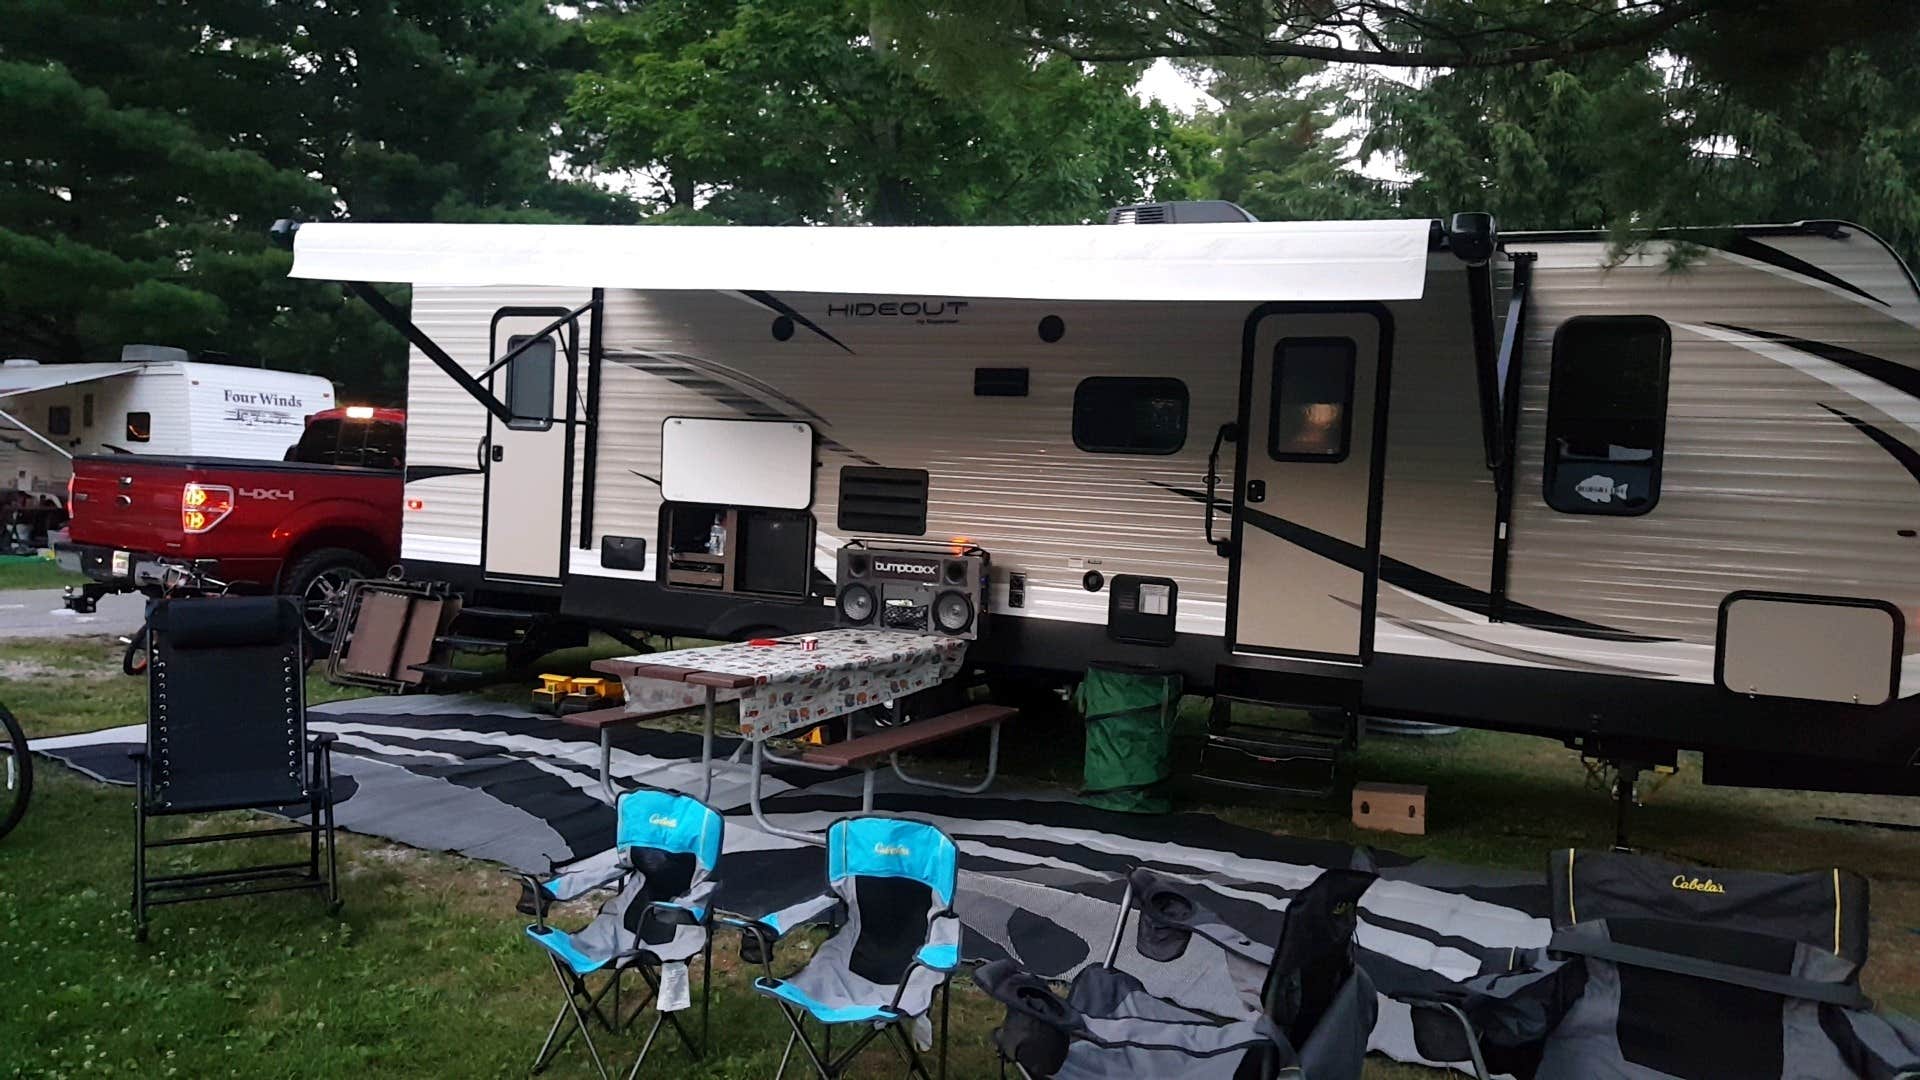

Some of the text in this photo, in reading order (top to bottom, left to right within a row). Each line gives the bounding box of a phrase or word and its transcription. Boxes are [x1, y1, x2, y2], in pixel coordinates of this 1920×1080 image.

[828, 301, 969, 317] HIDEOUT
[223, 389, 303, 408] Four Winds
[874, 561, 936, 575] bumpboxx
